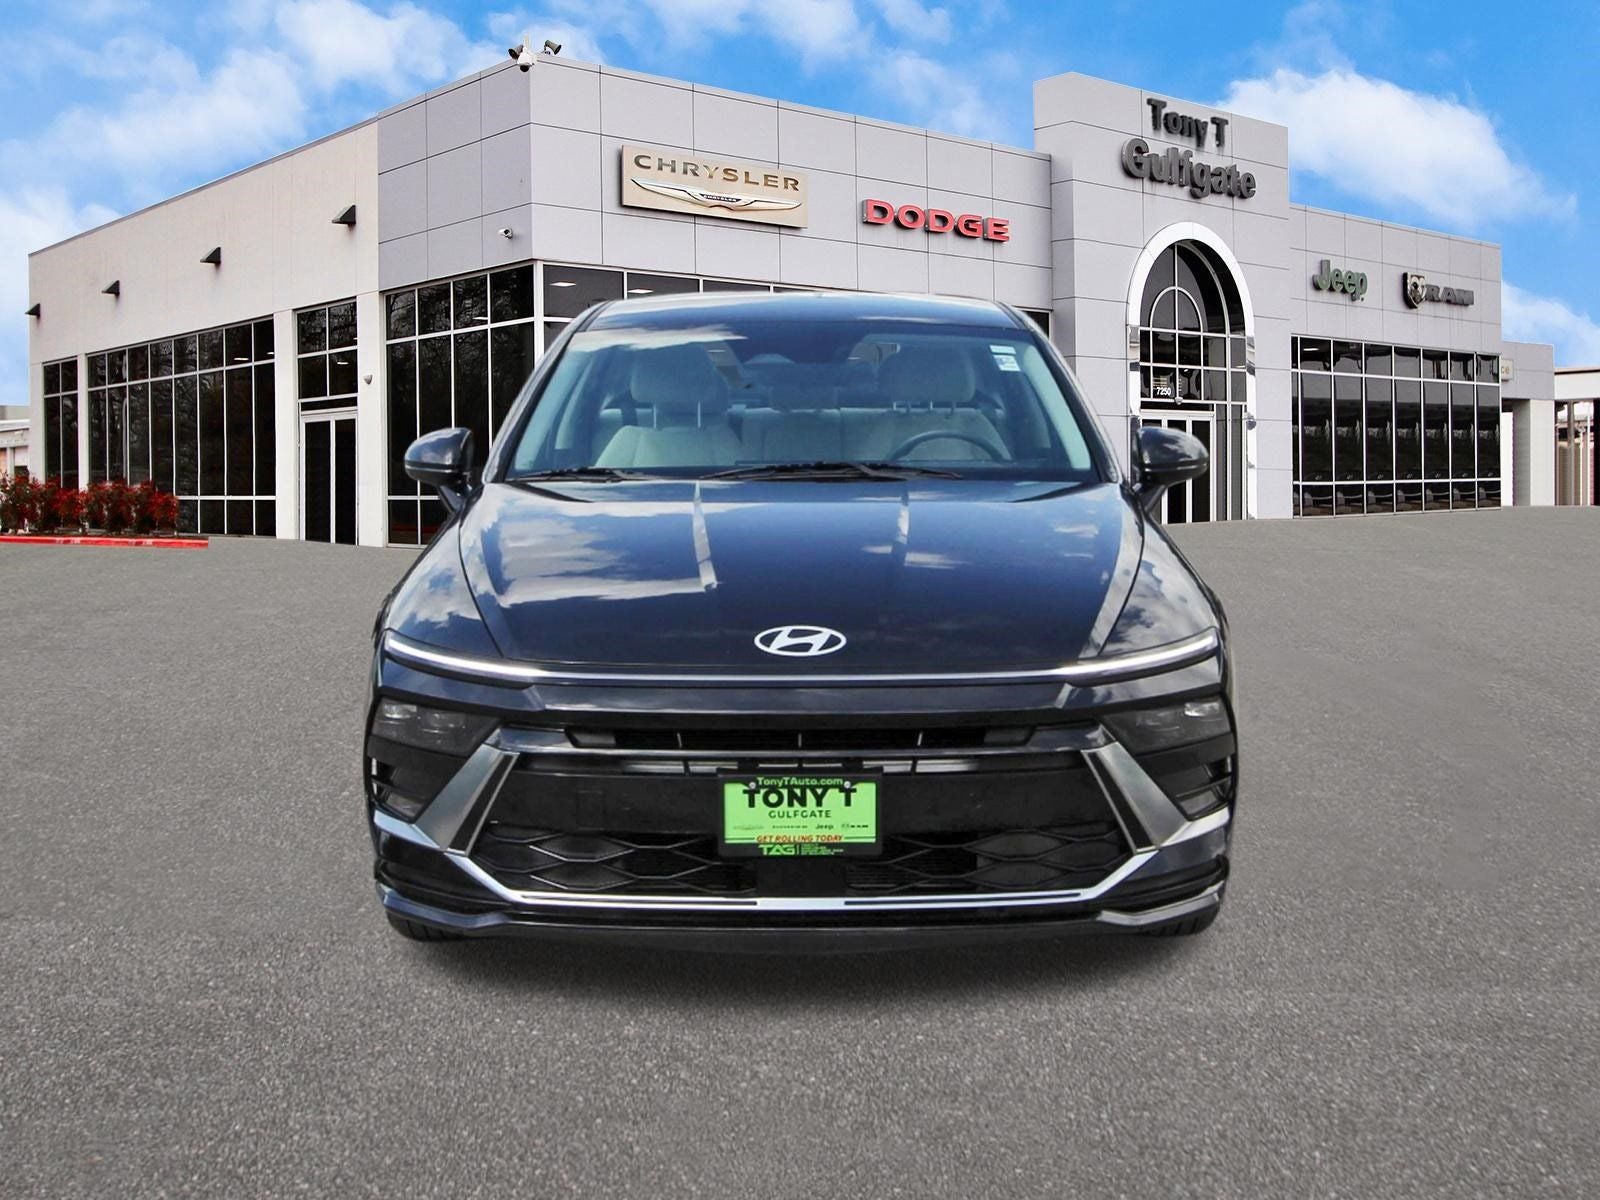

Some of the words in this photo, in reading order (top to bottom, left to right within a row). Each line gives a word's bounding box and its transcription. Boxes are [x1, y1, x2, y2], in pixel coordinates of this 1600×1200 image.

[1146, 97, 1208, 147] Tony
[1211, 116, 1229, 147] T
[633, 153, 800, 192] CHRYSLER
[1121, 137, 1257, 199] Gulfgate
[862, 198, 1011, 242] DODGE
[1312, 259, 1368, 301] Jeep
[1424, 283, 1475, 307] RAM
[1156, 387, 1172, 396] 7250
[756, 776, 844, 787] TonyTAuto.com
[742, 787, 830, 808] TONY
[839, 787, 857, 807] T
[768, 809, 832, 819] GULFGATE
[756, 835, 774, 843] GET
[775, 834, 814, 843] ROLLING
[815, 834, 843, 842] TODAY
[758, 844, 795, 855] TAG
